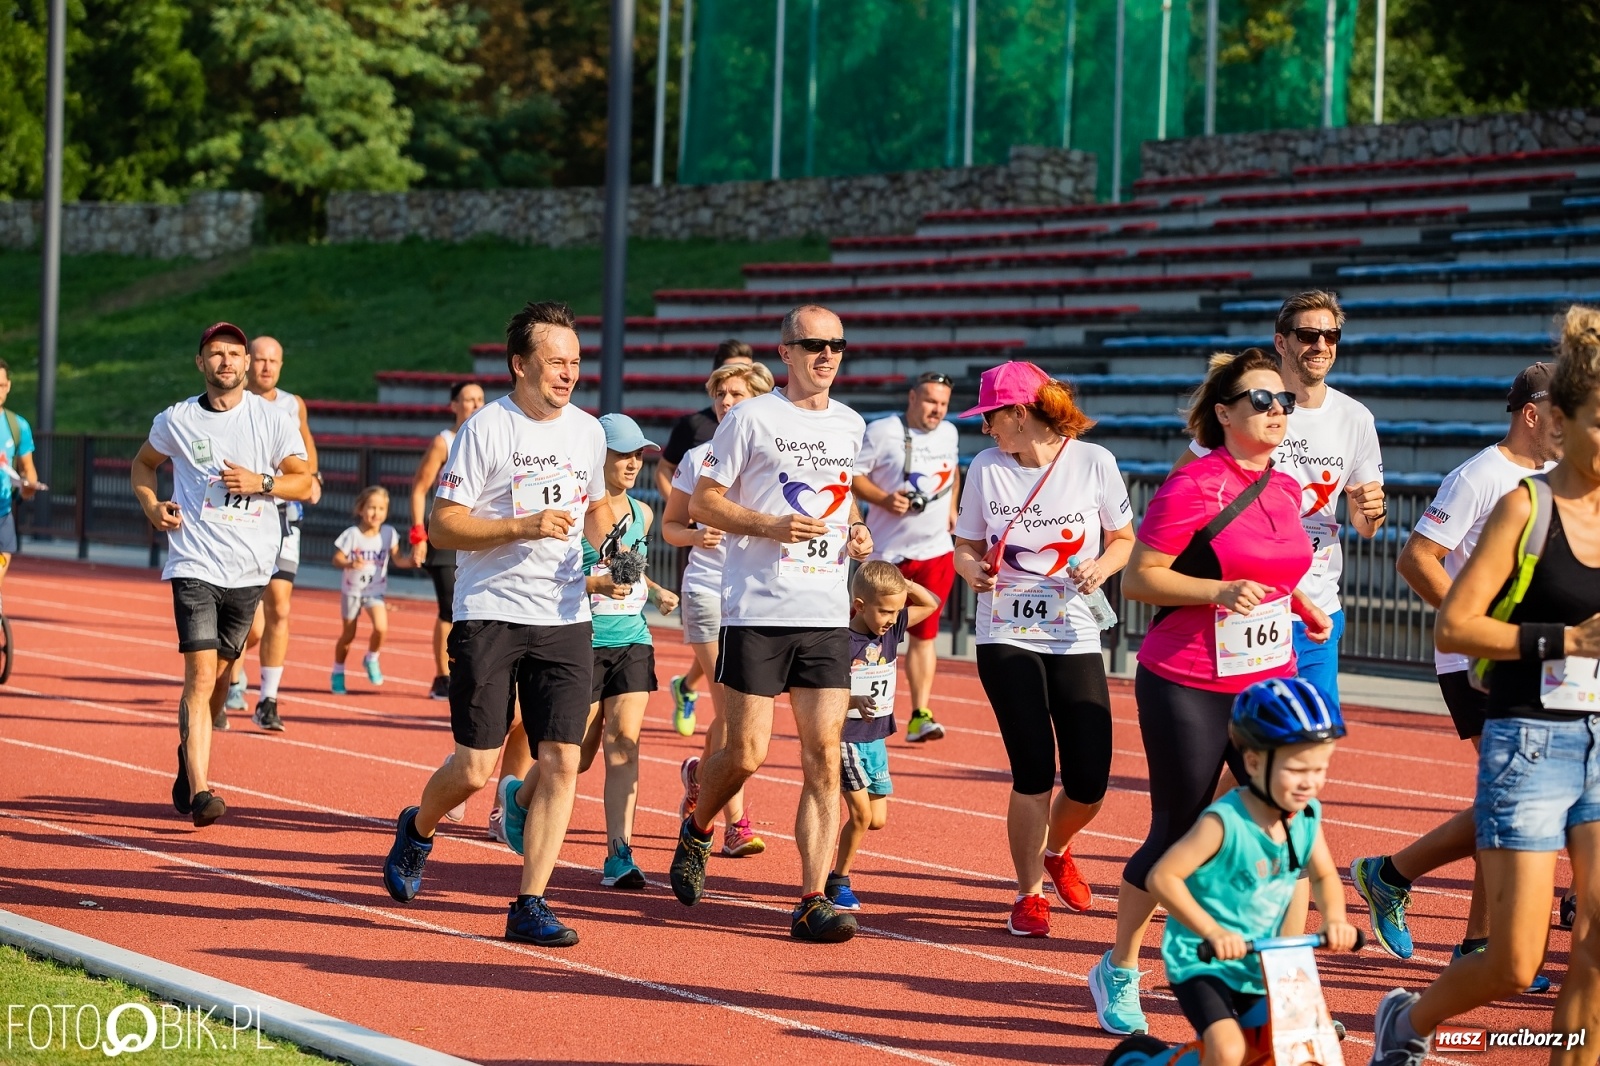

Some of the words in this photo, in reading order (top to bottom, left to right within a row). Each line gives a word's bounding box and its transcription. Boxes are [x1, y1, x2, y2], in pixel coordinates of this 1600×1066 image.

[775, 437, 827, 460] Biegnę
[512, 451, 559, 471] Biegnę
[794, 455, 805, 467] z
[1277, 452, 1287, 464] z
[1292, 454, 1344, 471] pomocą
[224, 492, 251, 511] 121
[541, 483, 562, 505] 13
[989, 500, 1043, 524] Biegnę
[1024, 512, 1086, 533] pomocą
[807, 539, 829, 558] 58
[1012, 600, 1048, 619] 164
[1244, 621, 1279, 648] 166
[870, 679, 889, 698] 57
